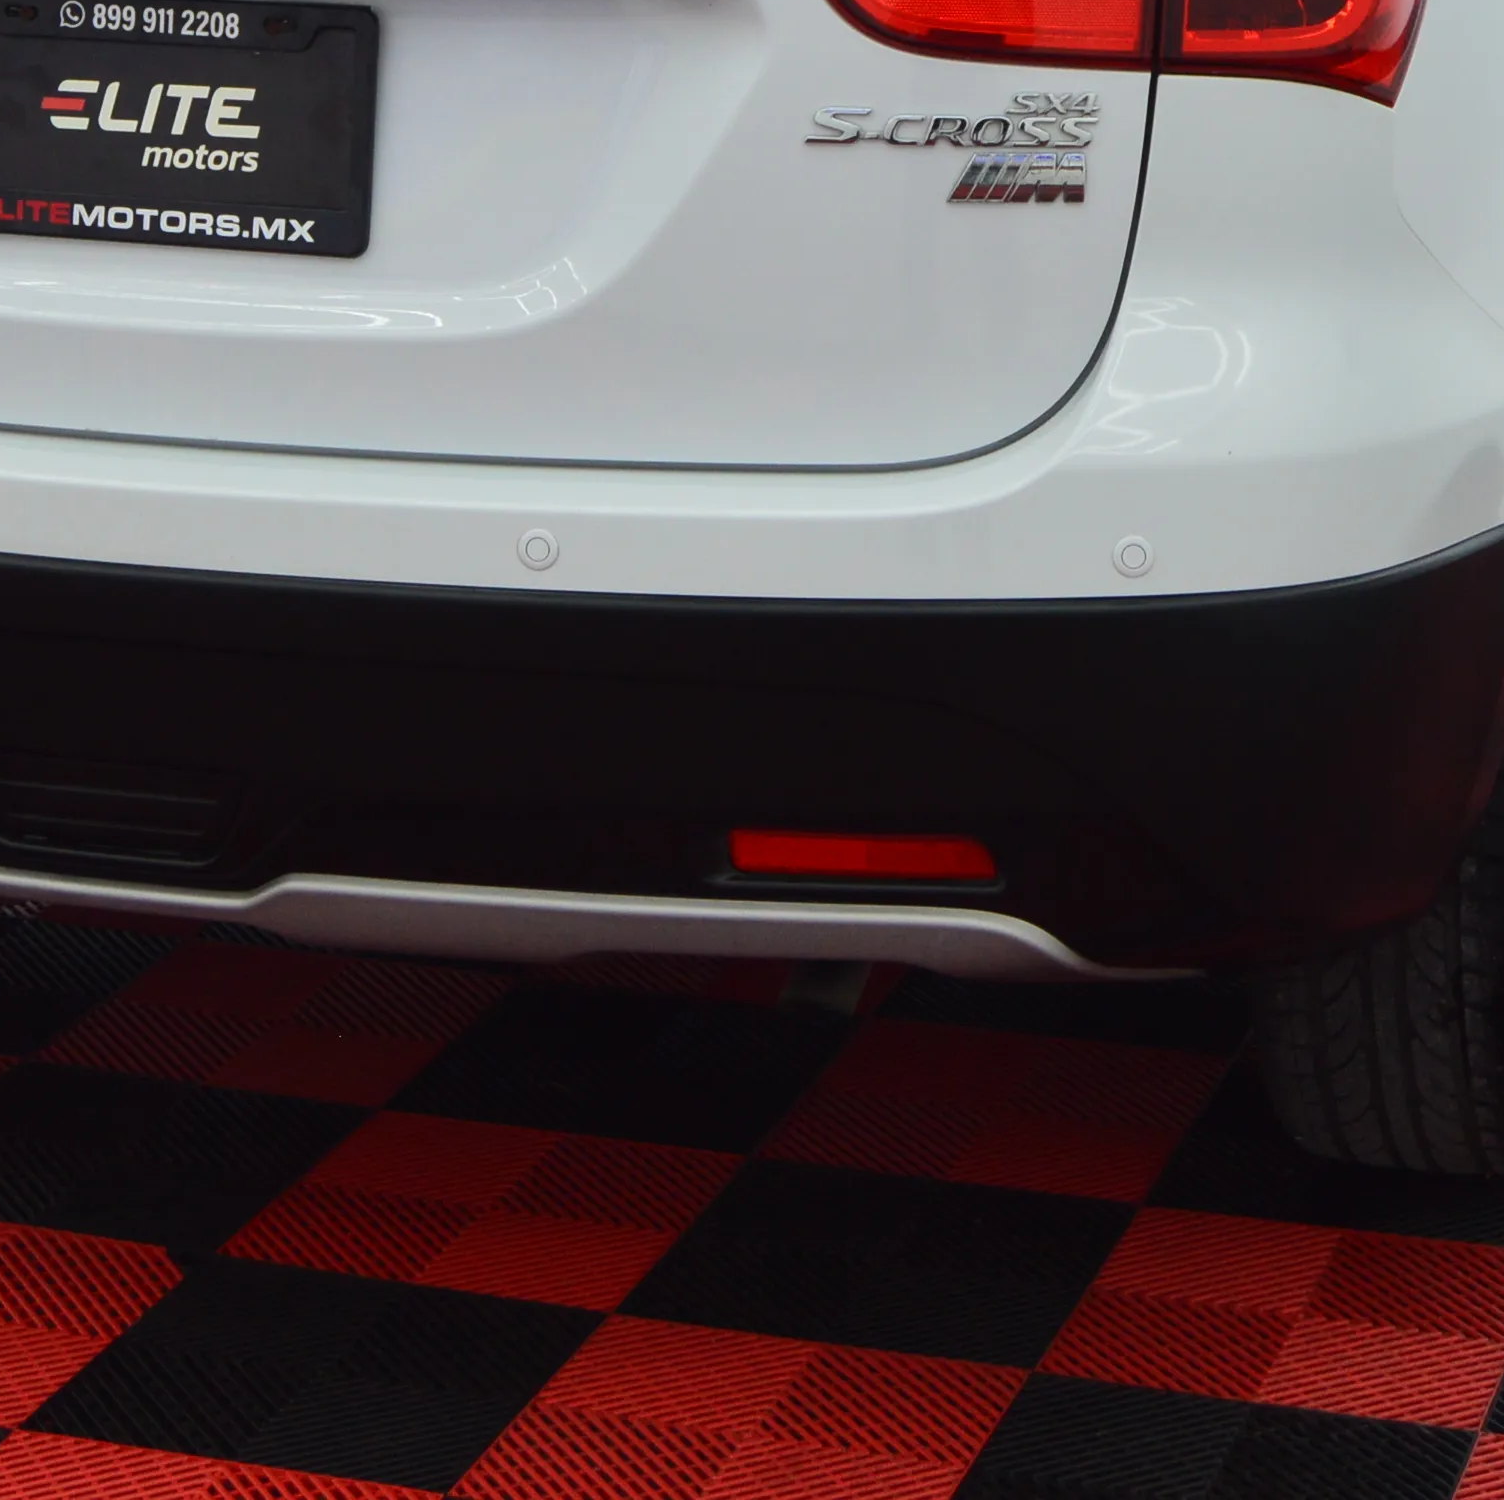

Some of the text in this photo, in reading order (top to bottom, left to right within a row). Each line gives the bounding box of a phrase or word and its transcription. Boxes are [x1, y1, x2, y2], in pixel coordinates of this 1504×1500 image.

[92, 2, 241, 39] 899 911 2208
[41, 78, 261, 139] ELITE
[1005, 91, 1101, 116] SX4
[804, 105, 1100, 148] S-CROSS
[141, 144, 260, 173] motors
